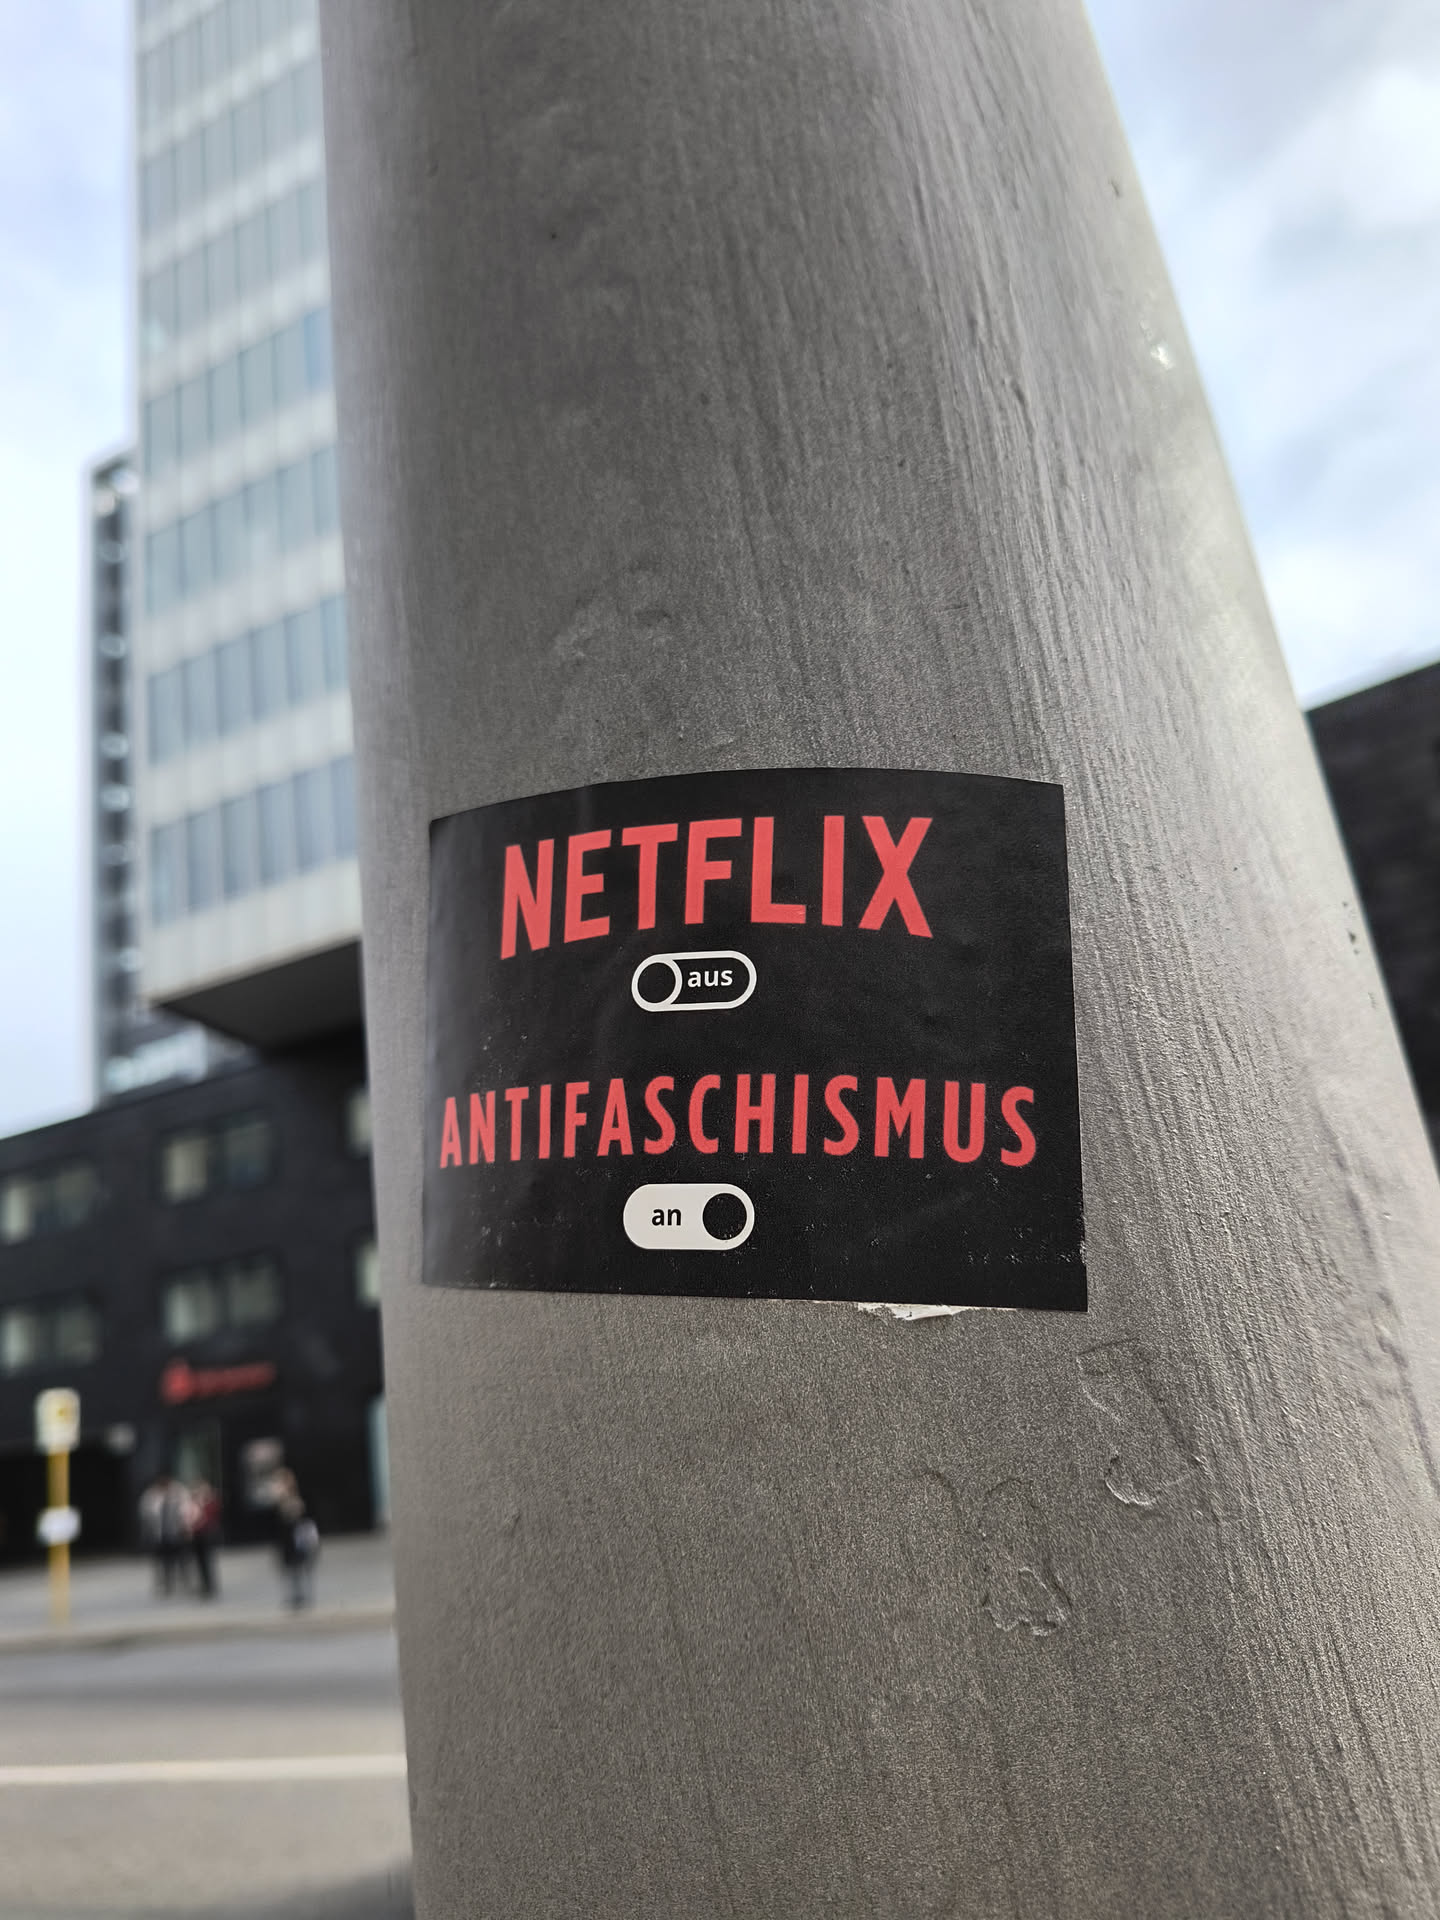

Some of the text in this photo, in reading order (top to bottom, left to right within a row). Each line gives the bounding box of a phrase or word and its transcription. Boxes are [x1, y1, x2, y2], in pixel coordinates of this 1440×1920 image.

[501, 816, 933, 960] NETFLIX
[687, 970, 733, 987] aus
[439, 1074, 1036, 1168] ANTIFASCHISMUS
[651, 1208, 682, 1227] an
